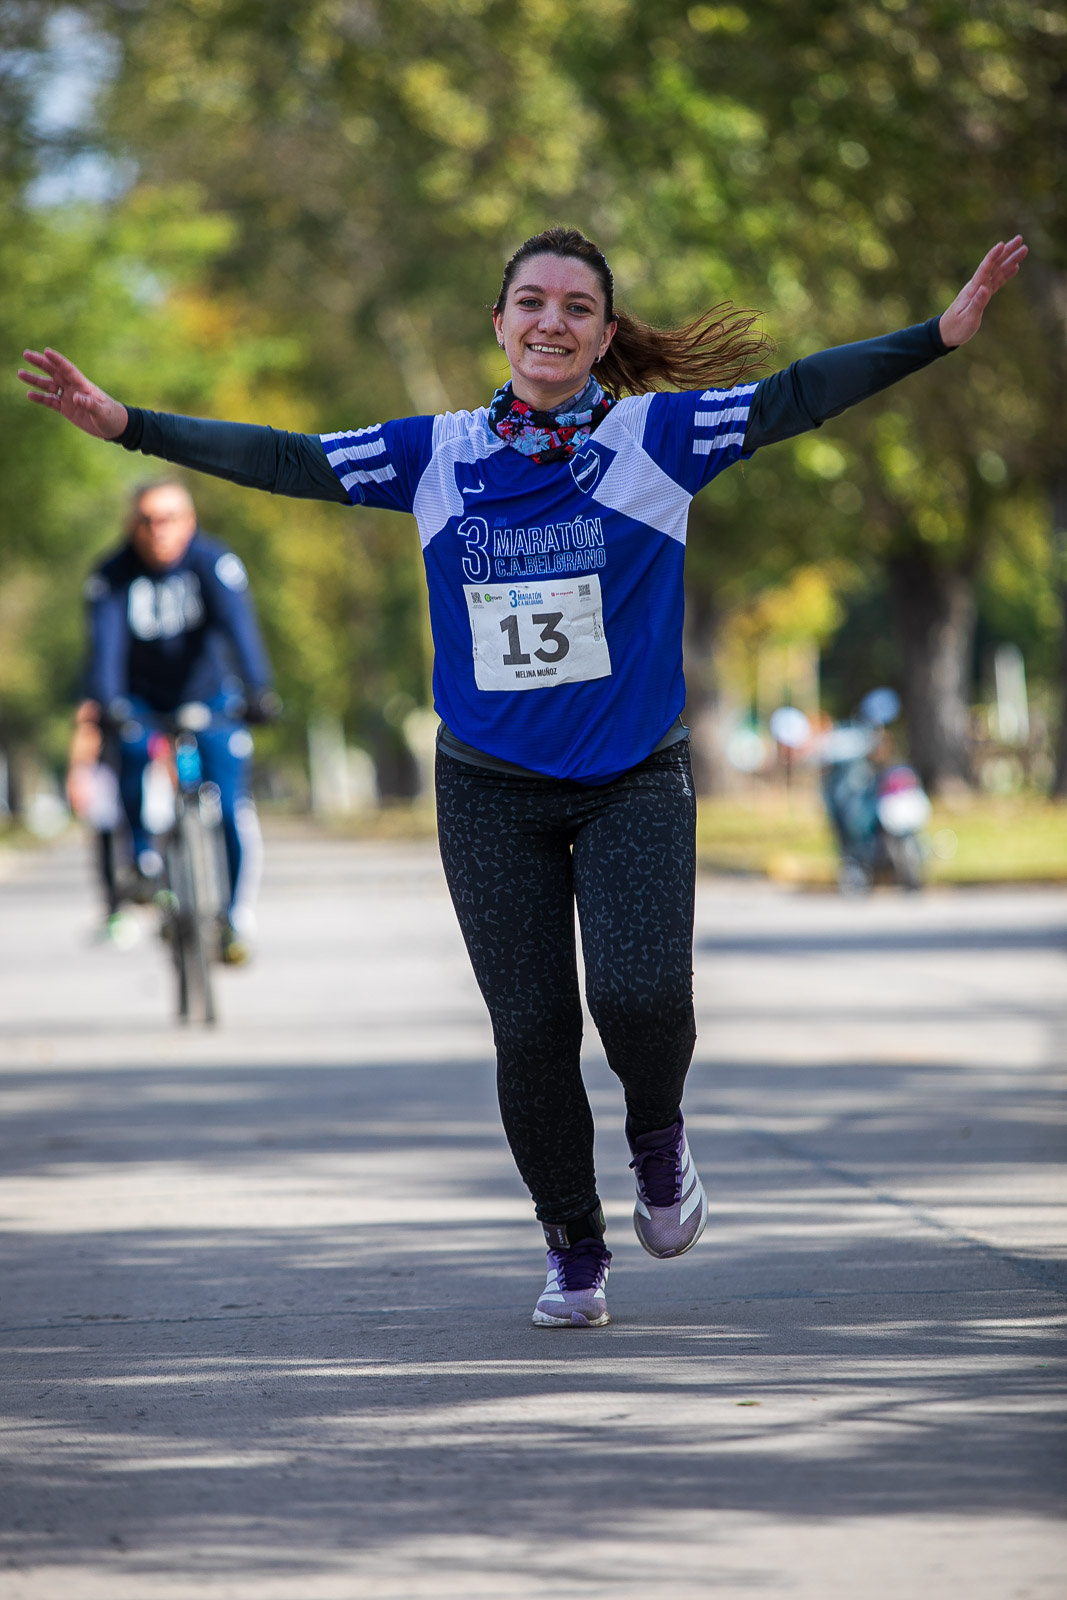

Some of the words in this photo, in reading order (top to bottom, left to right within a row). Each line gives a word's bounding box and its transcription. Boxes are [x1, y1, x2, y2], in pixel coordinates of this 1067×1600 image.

[457, 516, 491, 583] 3
[494, 515, 605, 557] MARATÓN
[508, 589, 518, 609] 3
[499, 611, 570, 666] 13
[515, 669, 537, 679] MELINA
[537, 667, 558, 677] MUÑOZ
